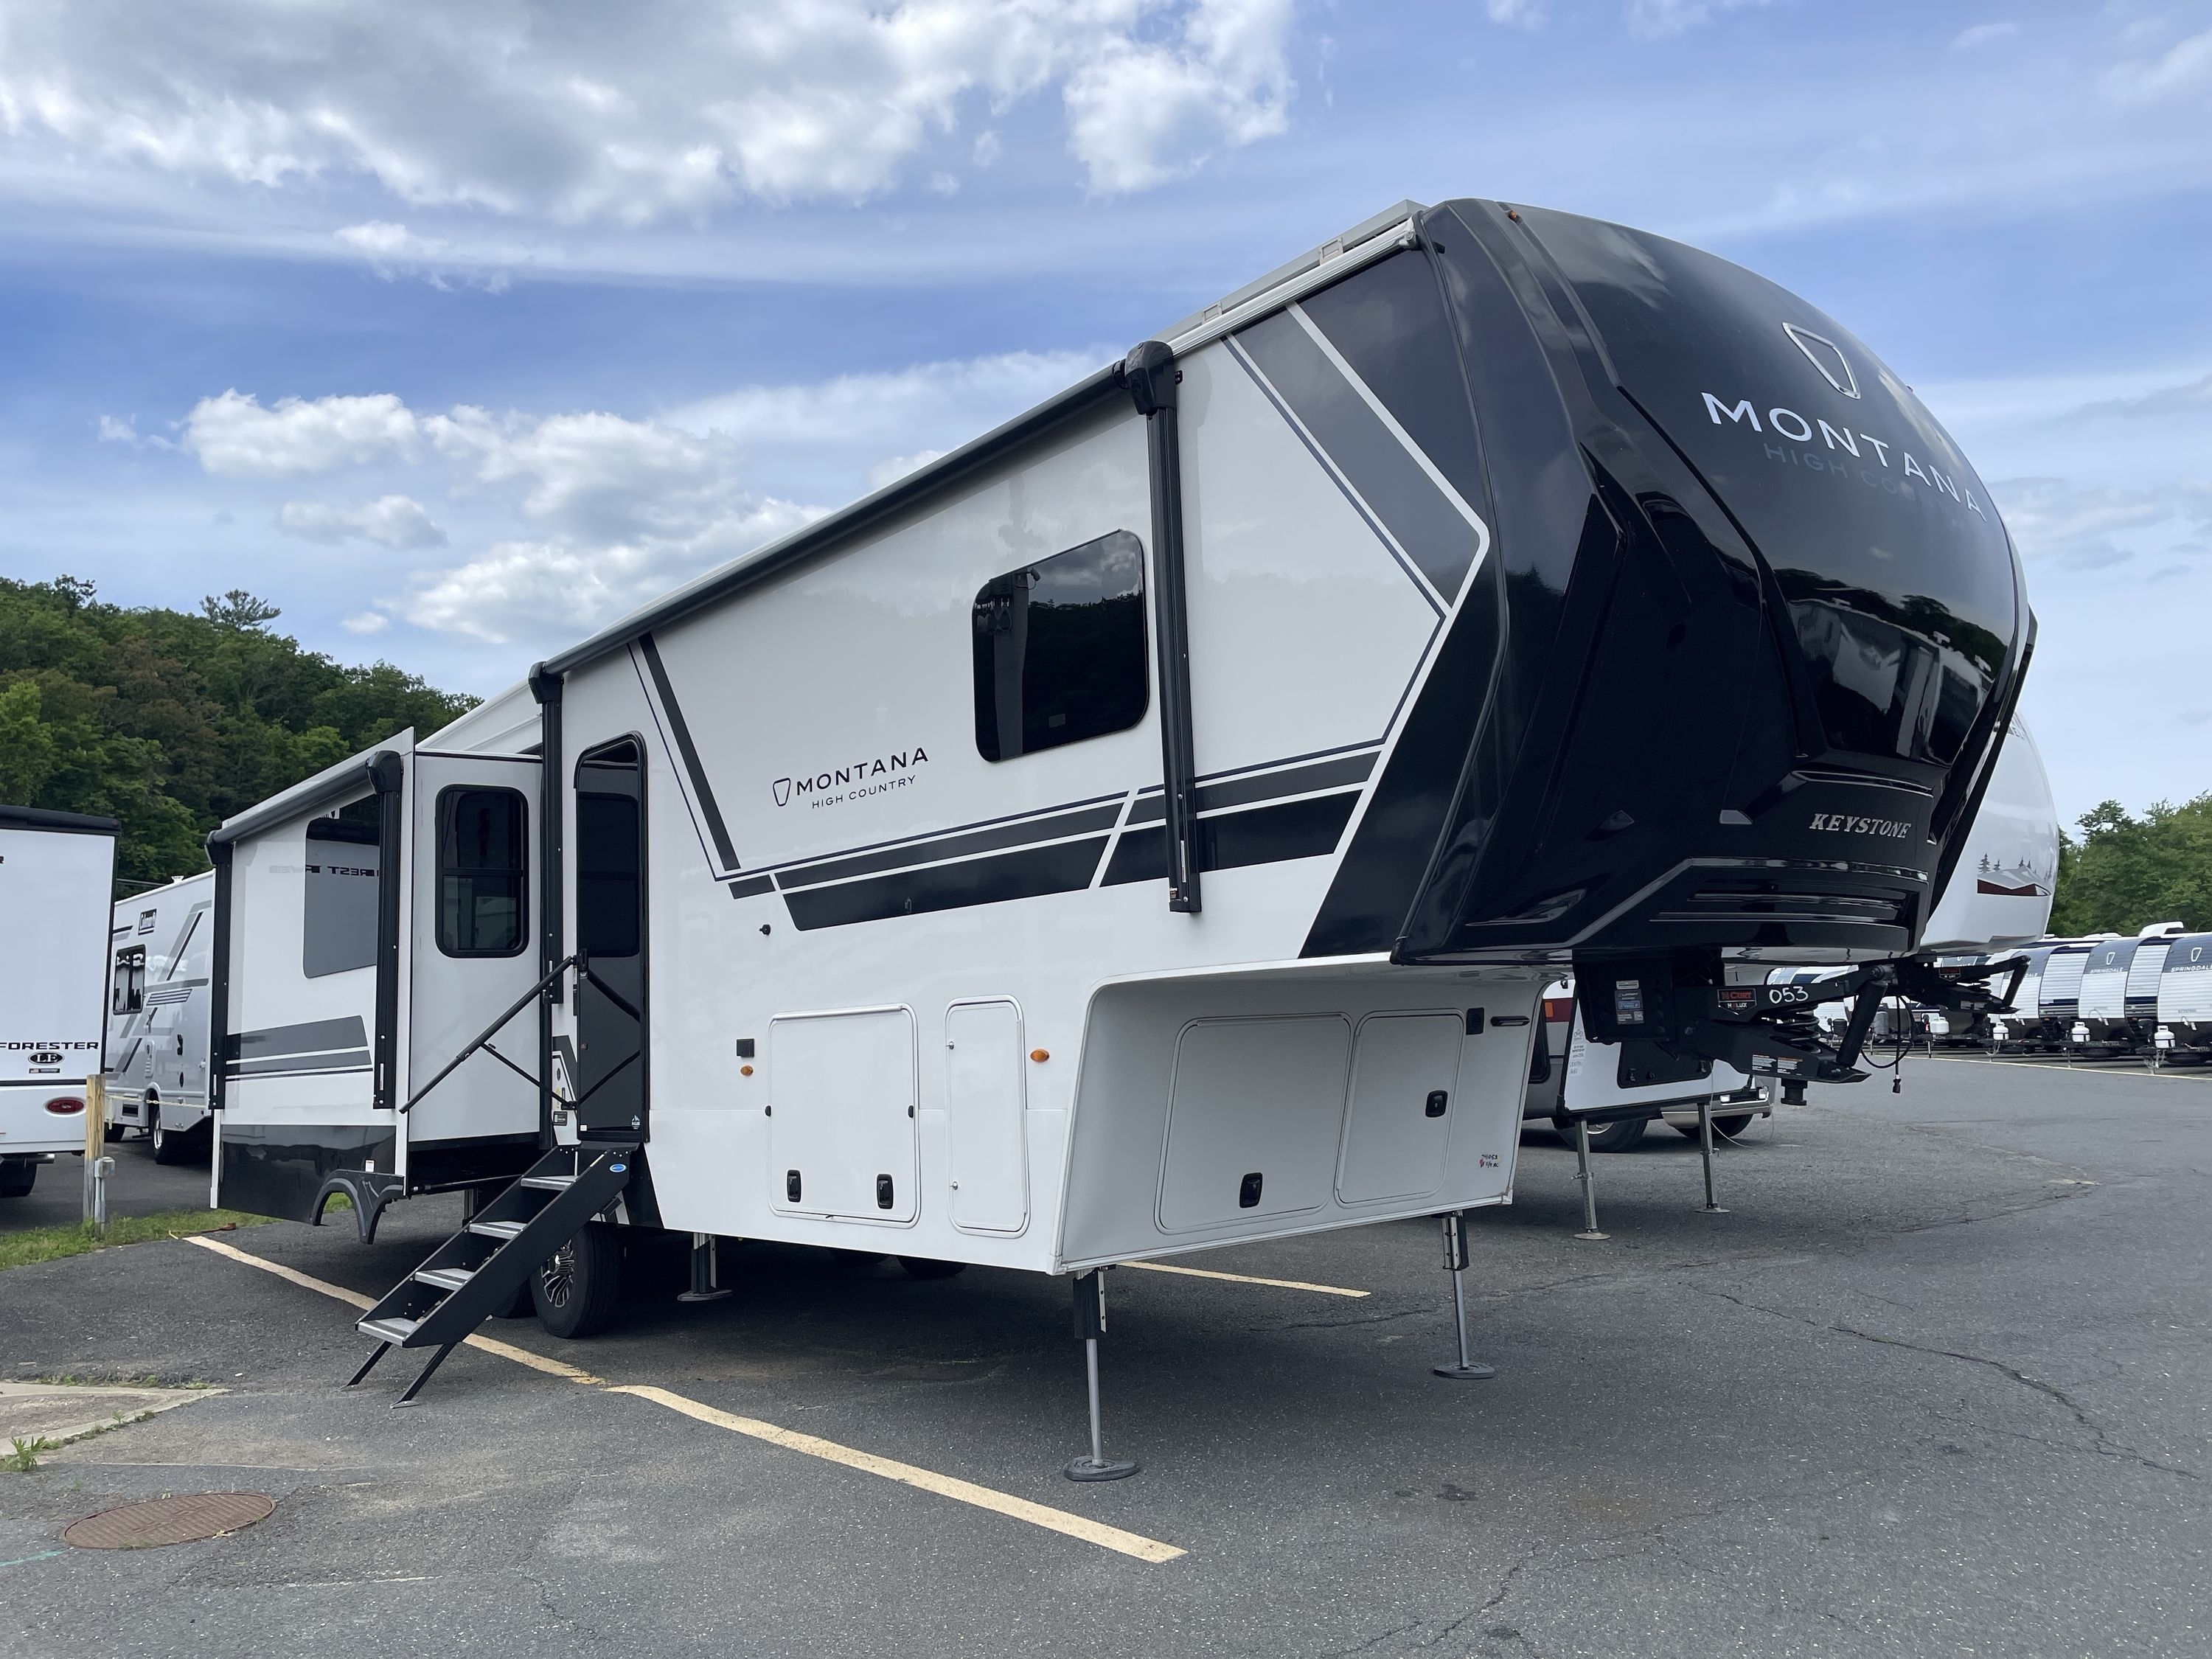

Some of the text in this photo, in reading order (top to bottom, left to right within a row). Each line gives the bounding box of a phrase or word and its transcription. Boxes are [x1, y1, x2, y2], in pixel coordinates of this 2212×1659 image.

[1700, 391, 1987, 523] MONTANA
[1762, 442, 1848, 479] HIGH
[796, 747, 929, 796] MONTANA
[812, 775, 916, 810] HIGH COUNTRY
[1809, 813, 1912, 838] KEYSTONE
[1770, 986, 1809, 1004] 053
[36, 1054, 59, 1062] LE
